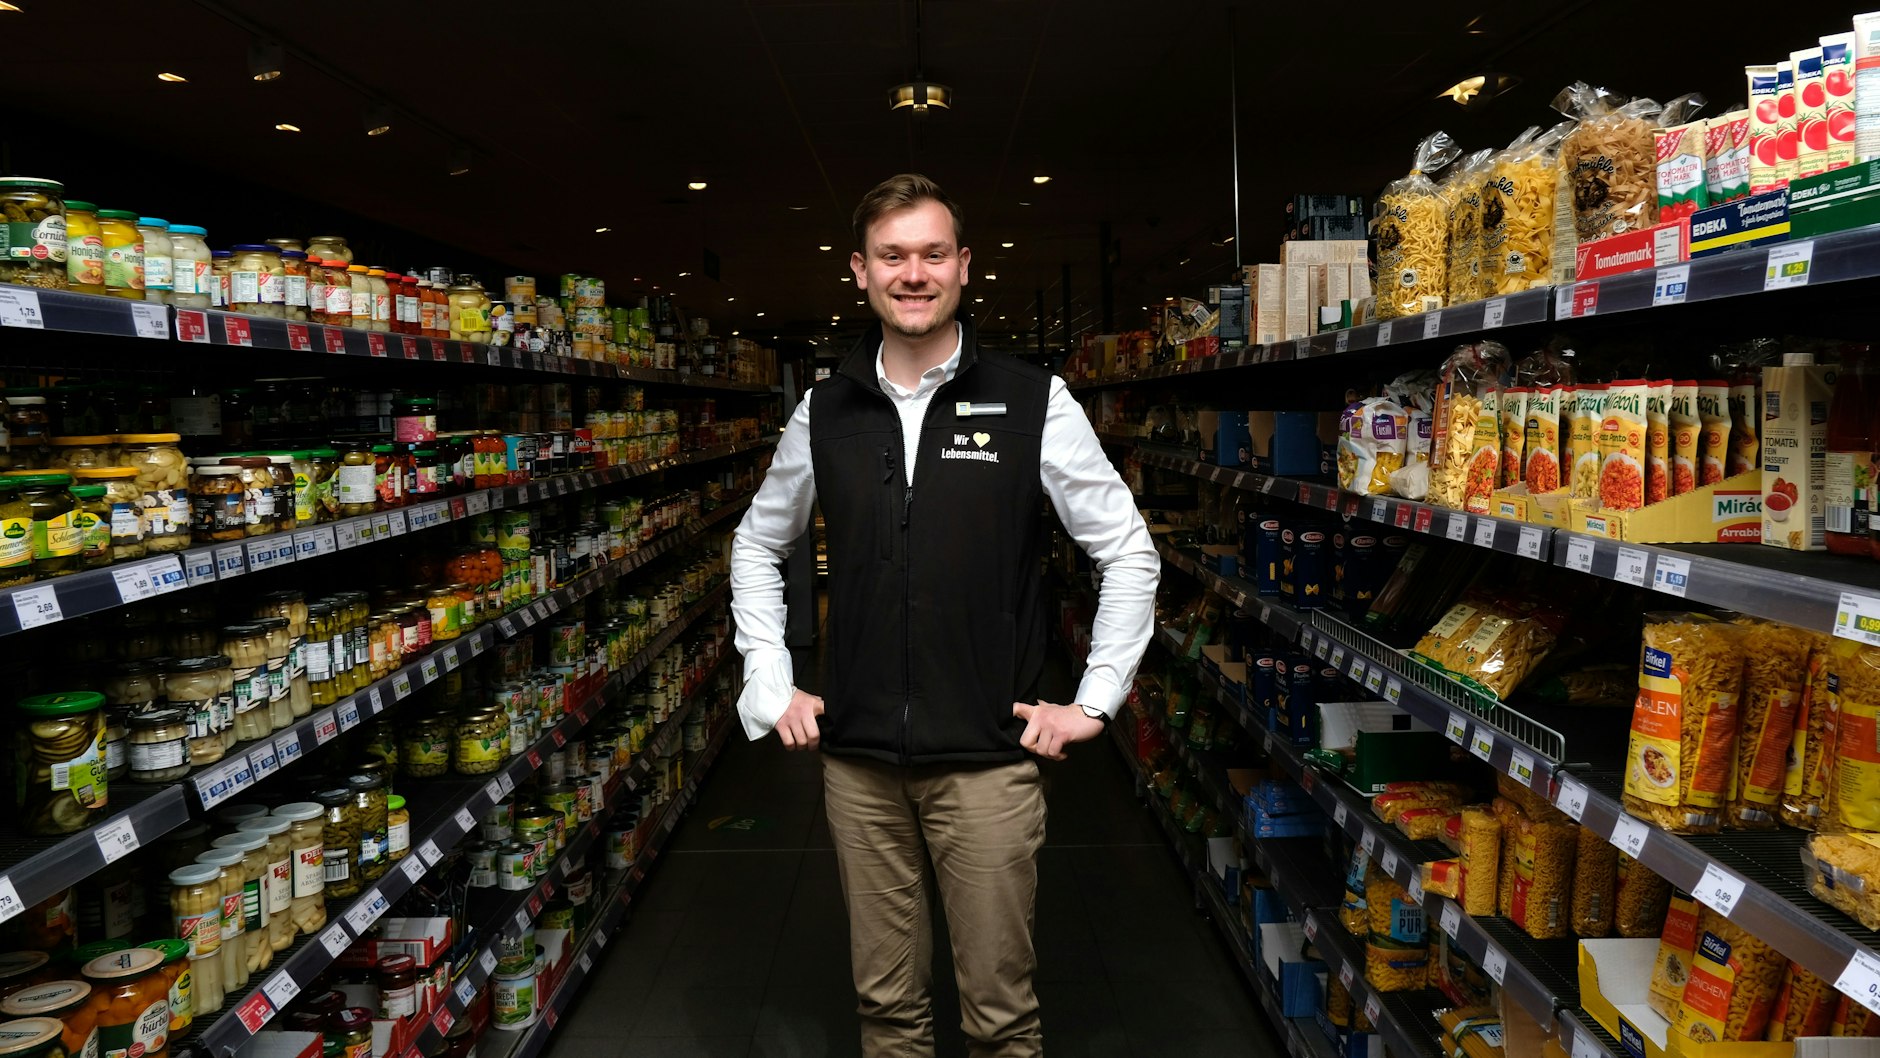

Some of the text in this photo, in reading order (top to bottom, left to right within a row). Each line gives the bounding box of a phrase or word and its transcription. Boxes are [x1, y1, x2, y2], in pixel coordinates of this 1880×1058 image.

[1823, 57, 1846, 67] EDEKA
[1797, 70, 1822, 80] EDEKA
[1752, 87, 1775, 95] EDEKA
[1674, 173, 1691, 182] MARK
[1792, 187, 1818, 201] EDEKA
[1819, 184, 1831, 194] Bio
[1692, 217, 1727, 237] EDEKA
[1594, 241, 1652, 270] Tomatenmark
[1786, 262, 1804, 276] 1,29
[19, 307, 36, 317] 1,79
[1607, 389, 1640, 416] Mirácoli
[1375, 424, 1393, 435] Fusilli
[953, 434, 969, 446] Wir
[1765, 437, 1798, 449] TOMATEN
[941, 447, 999, 463] Lebensmittel.
[1765, 447, 1777, 456] FEIN
[1765, 456, 1789, 465] PASSIERT
[166, 574, 180, 582] 1,19
[36, 602, 54, 614] 2,69
[1645, 650, 1666, 669] Birkel
[1570, 799, 1581, 810] 1,49
[117, 832, 131, 844] 1,89
[1628, 834, 1640, 846] 1,49
[1715, 888, 1732, 903] 0,99
[0, 895, 13, 909] ,79
[1399, 908, 1421, 917] GENUSS
[1399, 918, 1421, 934] PUR
[1703, 935, 1728, 957] Birkel
[496, 992, 515, 1001] BRECH
